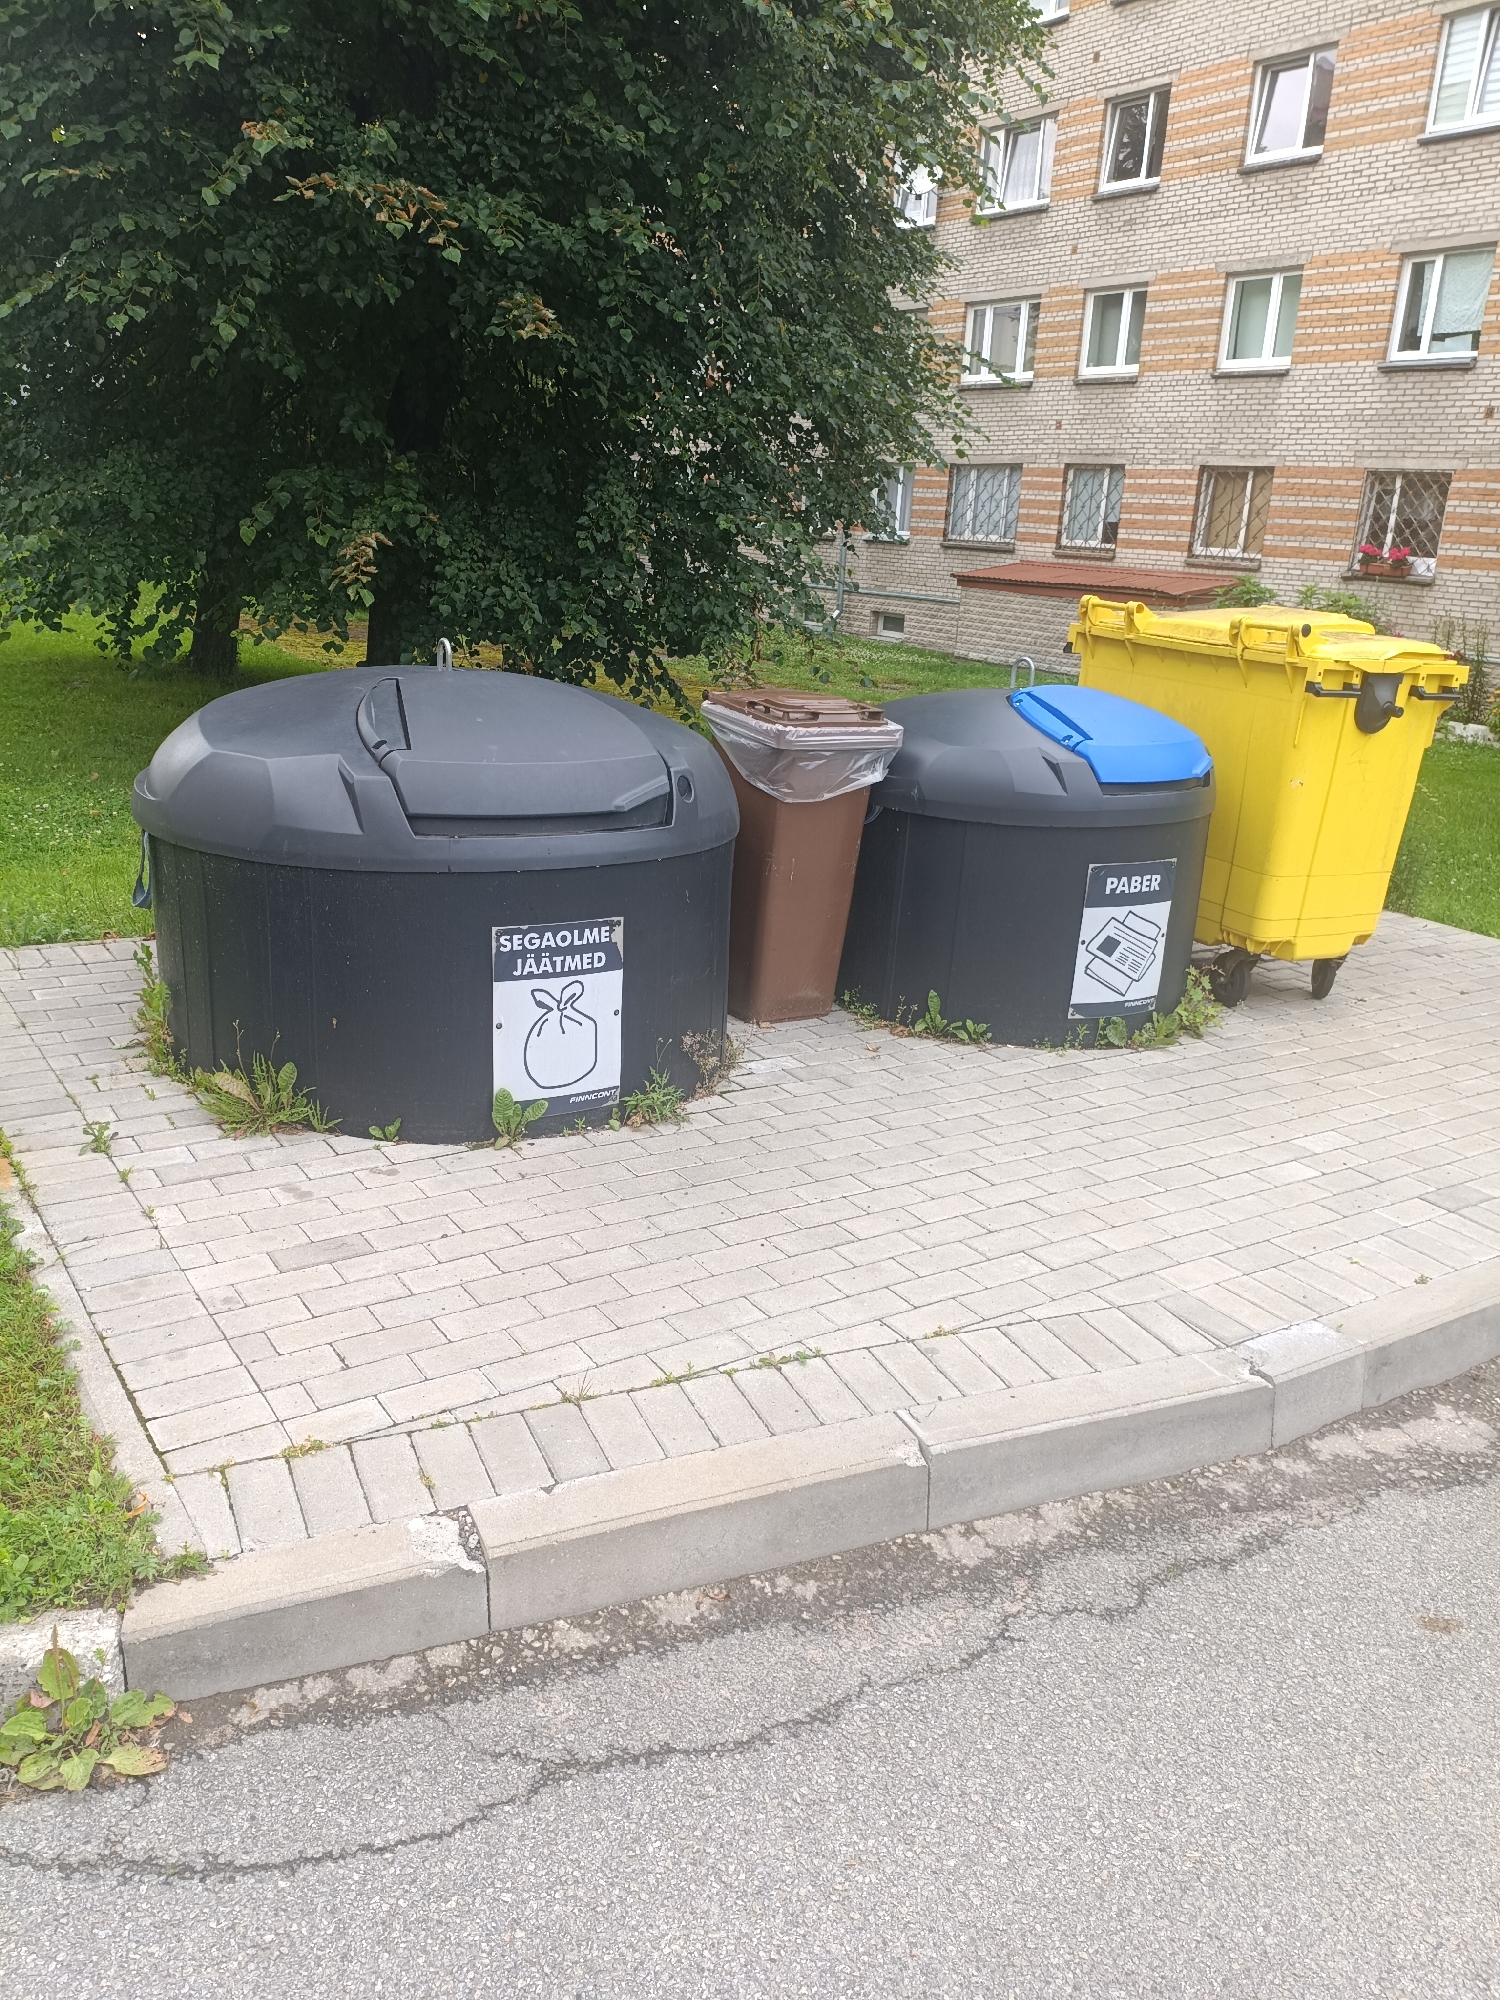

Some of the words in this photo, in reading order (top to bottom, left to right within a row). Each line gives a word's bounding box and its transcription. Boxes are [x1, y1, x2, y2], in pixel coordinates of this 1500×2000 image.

[1105, 874, 1161, 895] PABER
[500, 926, 610, 952] SEGAOLME
[513, 952, 606, 976] JÄÄTMED
[570, 1089, 617, 1104] FINNCONT
